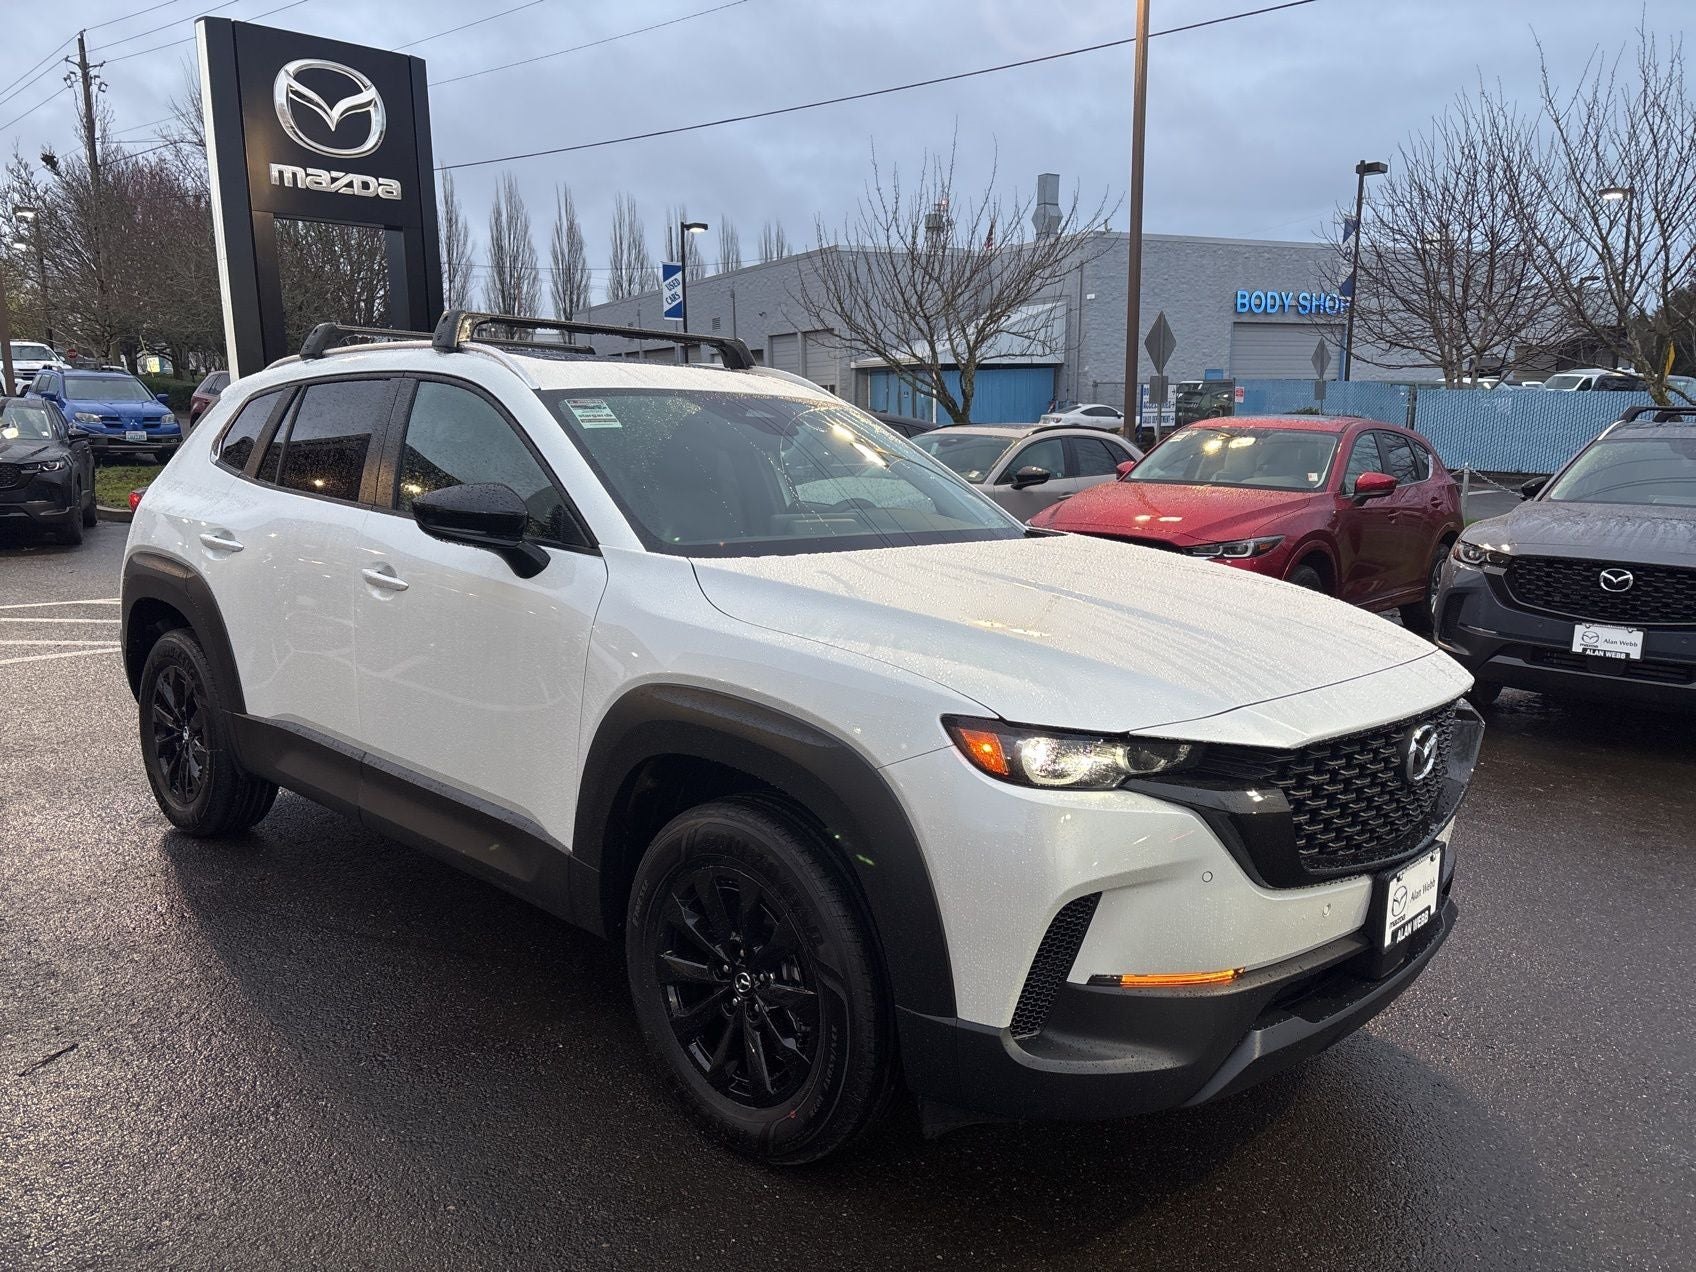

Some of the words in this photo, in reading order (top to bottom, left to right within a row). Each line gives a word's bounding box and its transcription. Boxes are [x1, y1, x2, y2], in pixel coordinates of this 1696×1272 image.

[269, 163, 402, 200] mazda
[664, 278, 680, 291] USED
[665, 292, 680, 305] CARS
[1236, 290, 1294, 314] BODY
[1586, 649, 1604, 657] ALAN
[1605, 651, 1626, 659] WEBB
[1410, 889, 1421, 902] Alan
[1423, 877, 1436, 893] Webb
[1397, 921, 1412, 943] ALAN
[1413, 910, 1429, 931] WEBB
